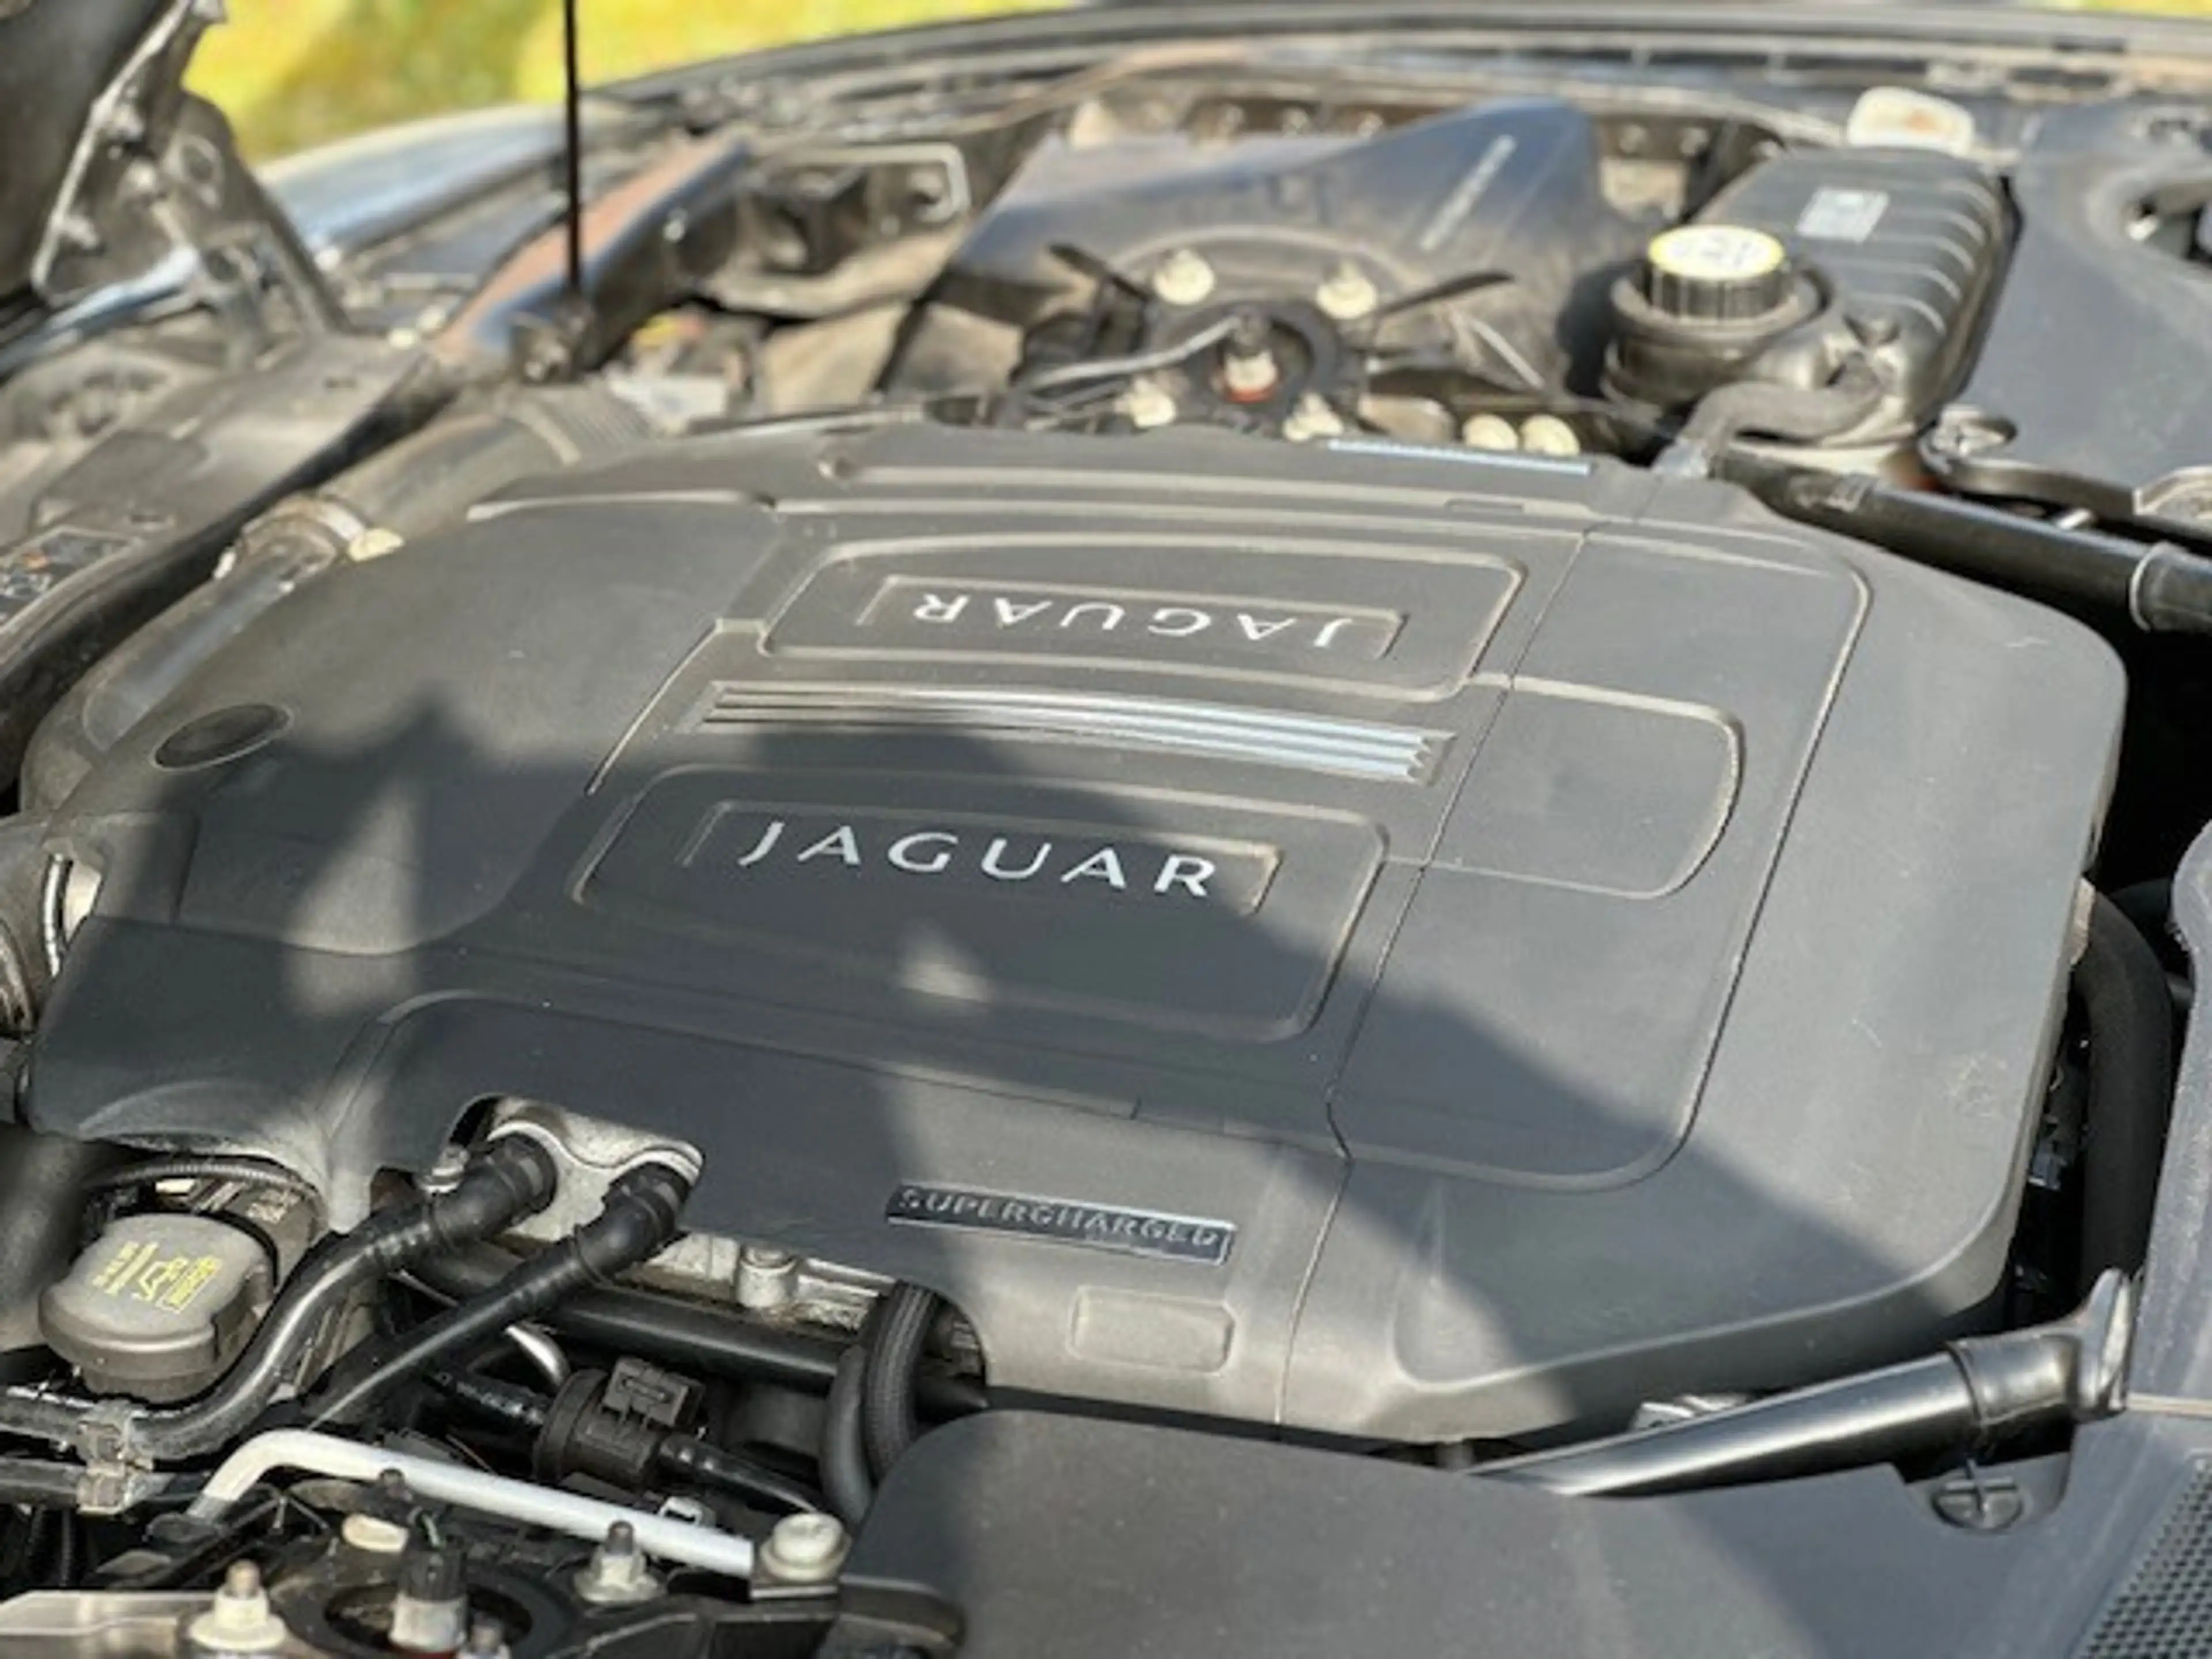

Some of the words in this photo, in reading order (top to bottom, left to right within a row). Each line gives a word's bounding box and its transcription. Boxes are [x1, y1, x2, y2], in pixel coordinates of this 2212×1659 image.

[914, 593, 1353, 647] JAGUAR
[738, 821, 1216, 897] JAGUAR
[900, 1188, 1219, 1246] SUPERCHARGED
